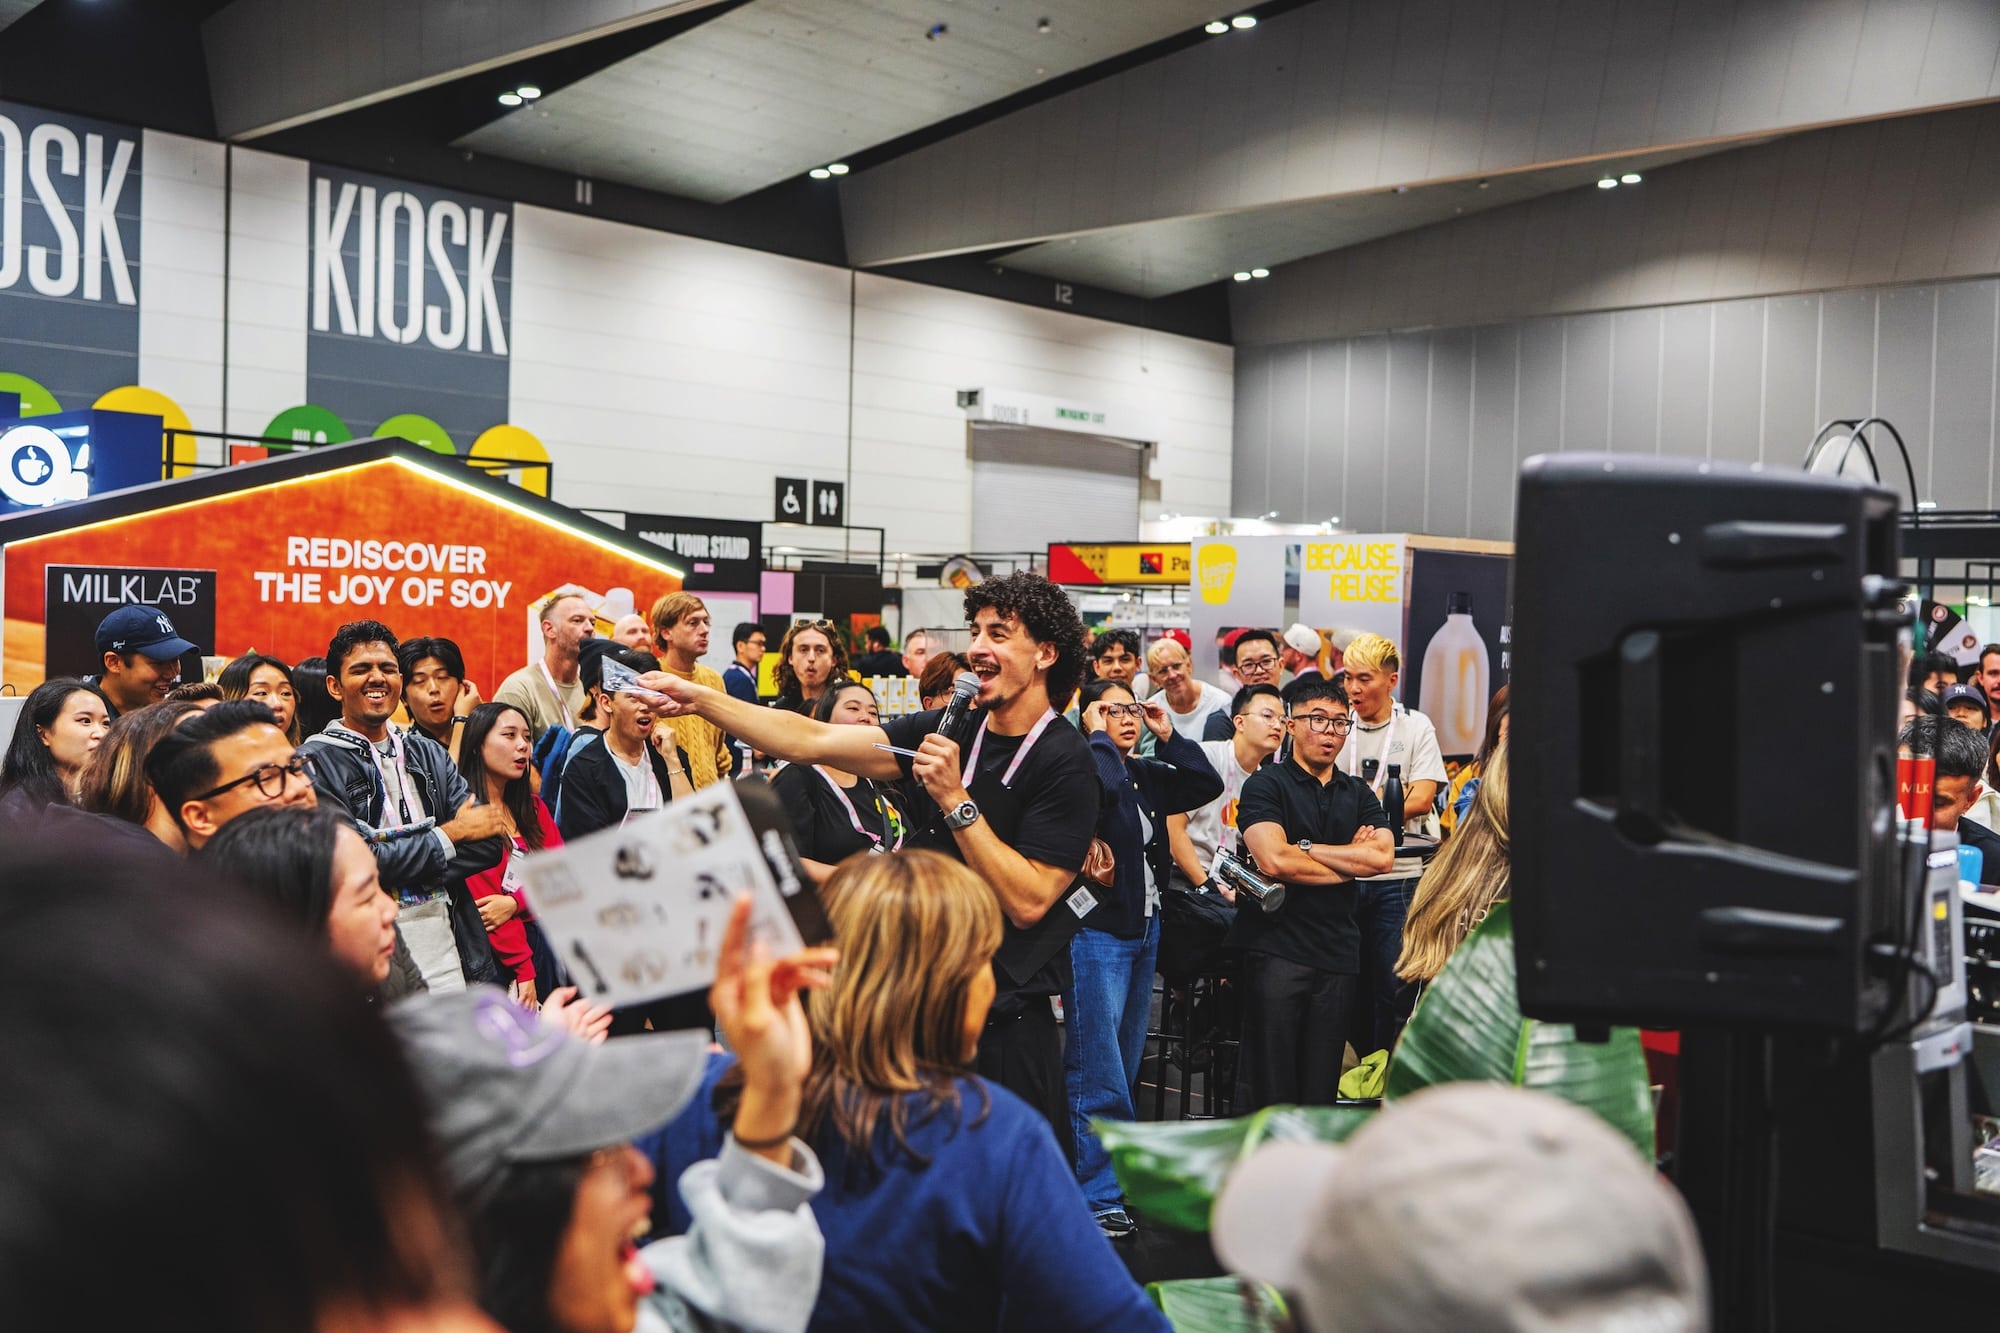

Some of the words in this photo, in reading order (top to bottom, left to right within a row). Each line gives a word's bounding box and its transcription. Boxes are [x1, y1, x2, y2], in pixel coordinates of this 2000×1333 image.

[313, 177, 509, 356] KIOSK
[1056, 283, 1073, 304] 12
[287, 536, 487, 574] REDISCOVER
[676, 533, 709, 558] YOUR
[710, 535, 750, 560] STAND
[1306, 543, 1400, 574] BECAUSE,
[254, 571, 321, 603] THE
[328, 575, 395, 605] JOY
[401, 577, 444, 607] OF
[450, 579, 512, 608] SOY
[1330, 573, 1399, 603] REUSE.
